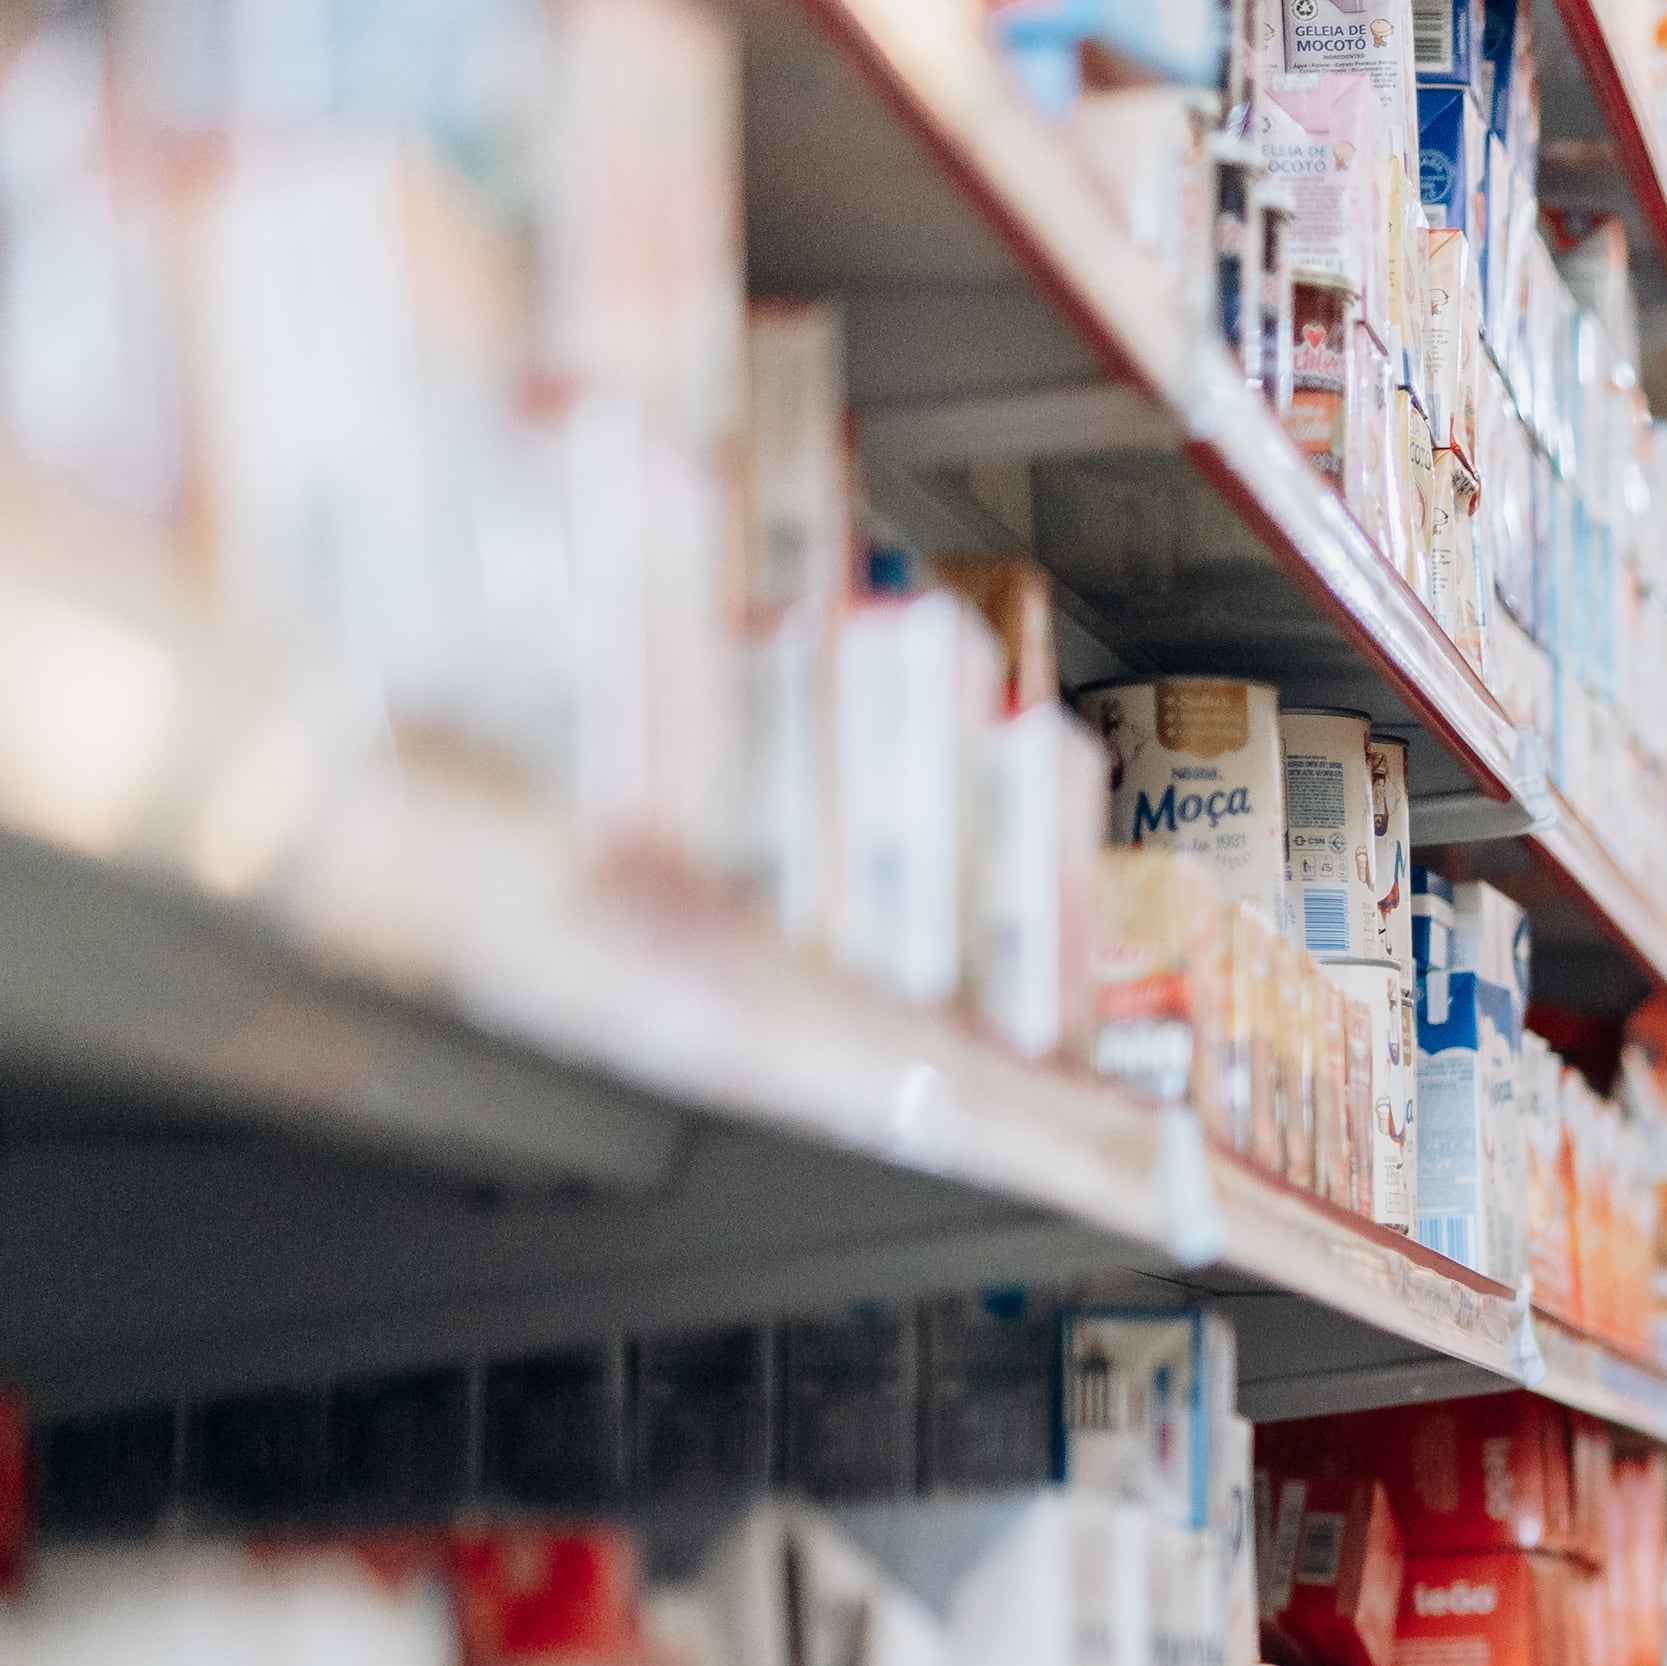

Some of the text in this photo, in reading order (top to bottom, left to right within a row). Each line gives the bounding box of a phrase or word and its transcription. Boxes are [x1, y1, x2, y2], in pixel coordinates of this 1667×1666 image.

[1295, 24, 1367, 37] GELEIA DE
[1296, 34, 1366, 52] MOCOTÓ
[1261, 144, 1304, 157] ELEIA
[1131, 783, 1252, 844] Moça
[1308, 834, 1325, 845] CSN
